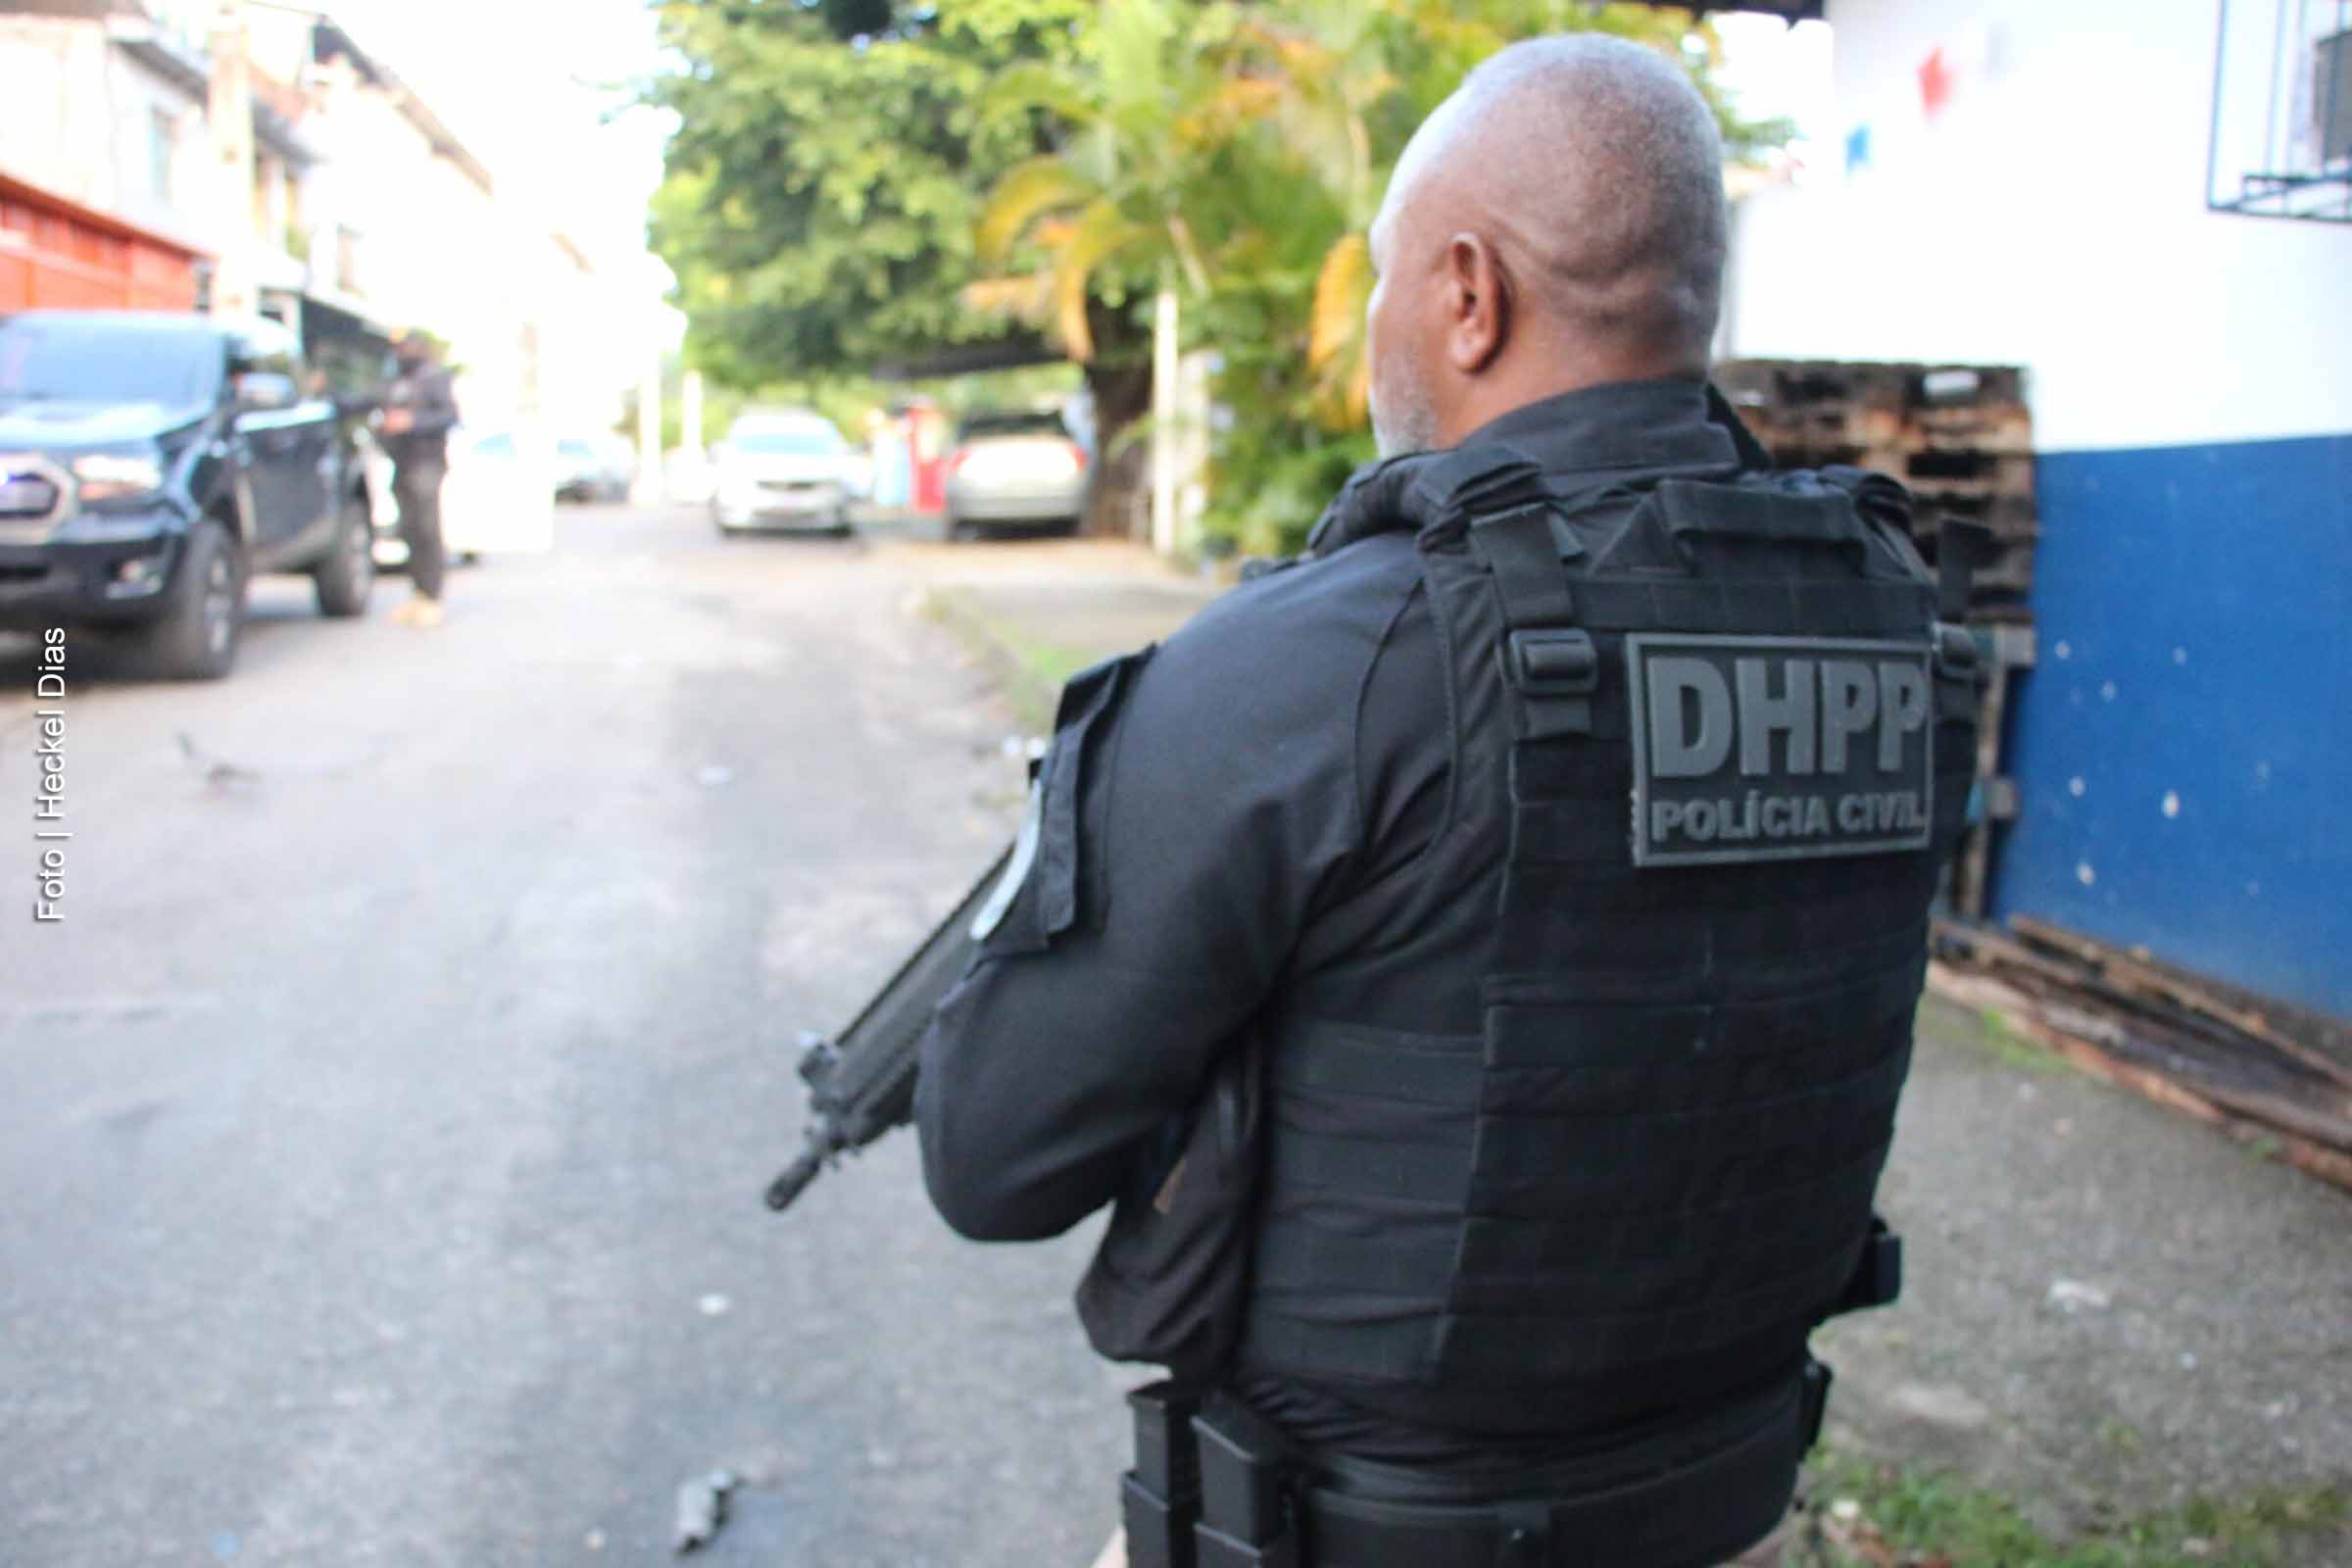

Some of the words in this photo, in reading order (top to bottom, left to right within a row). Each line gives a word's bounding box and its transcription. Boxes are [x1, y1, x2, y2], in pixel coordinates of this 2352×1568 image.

[1647, 657, 1929, 776] DHPP
[1651, 789, 1831, 842] POLÍCIA
[1837, 791, 1929, 831] CIVIL
